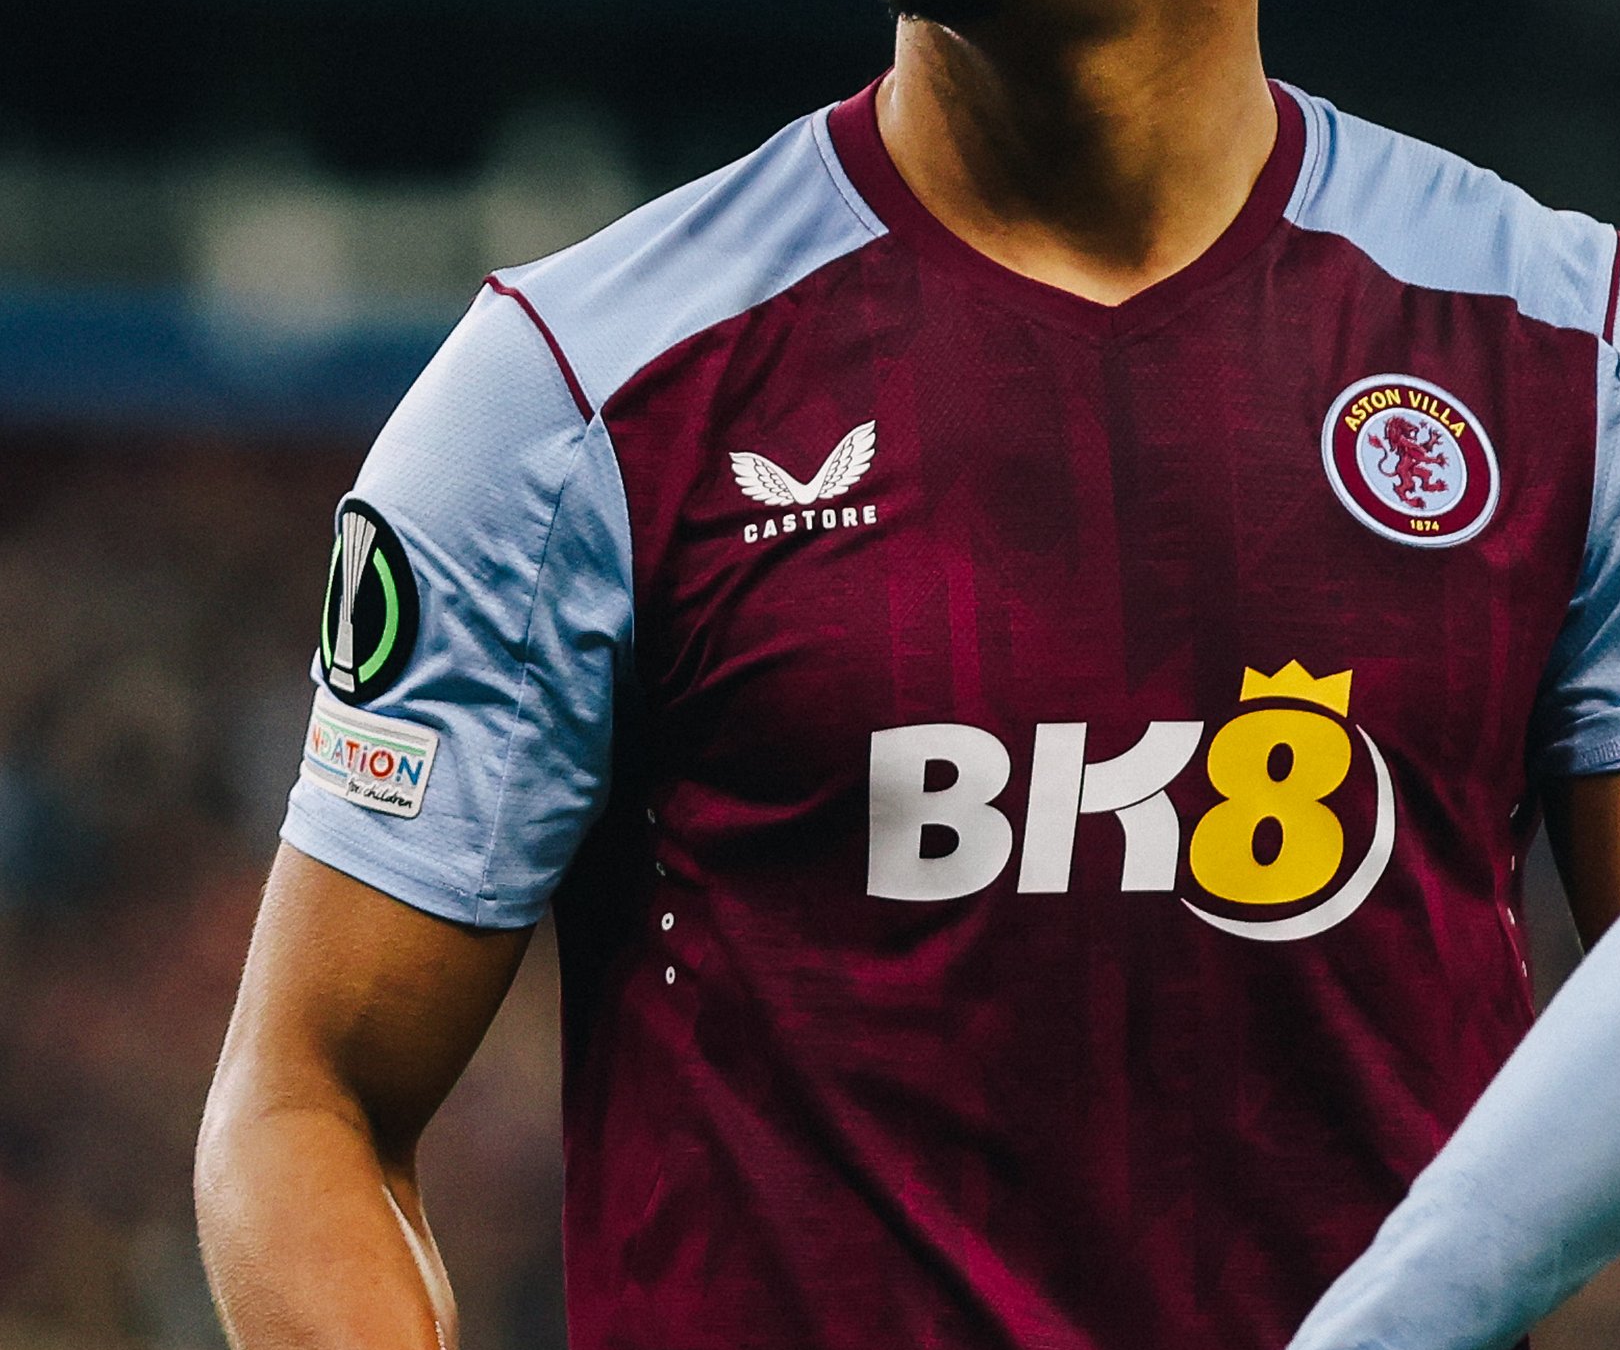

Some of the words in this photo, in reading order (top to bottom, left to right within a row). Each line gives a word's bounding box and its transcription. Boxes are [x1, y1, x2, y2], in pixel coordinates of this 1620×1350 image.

[1344, 388, 1401, 432] ASTON
[1408, 390, 1466, 438] VILLA
[744, 505, 877, 543] CASTORE
[1409, 519, 1440, 532] 1874
[867, 708, 1353, 905] BK8
